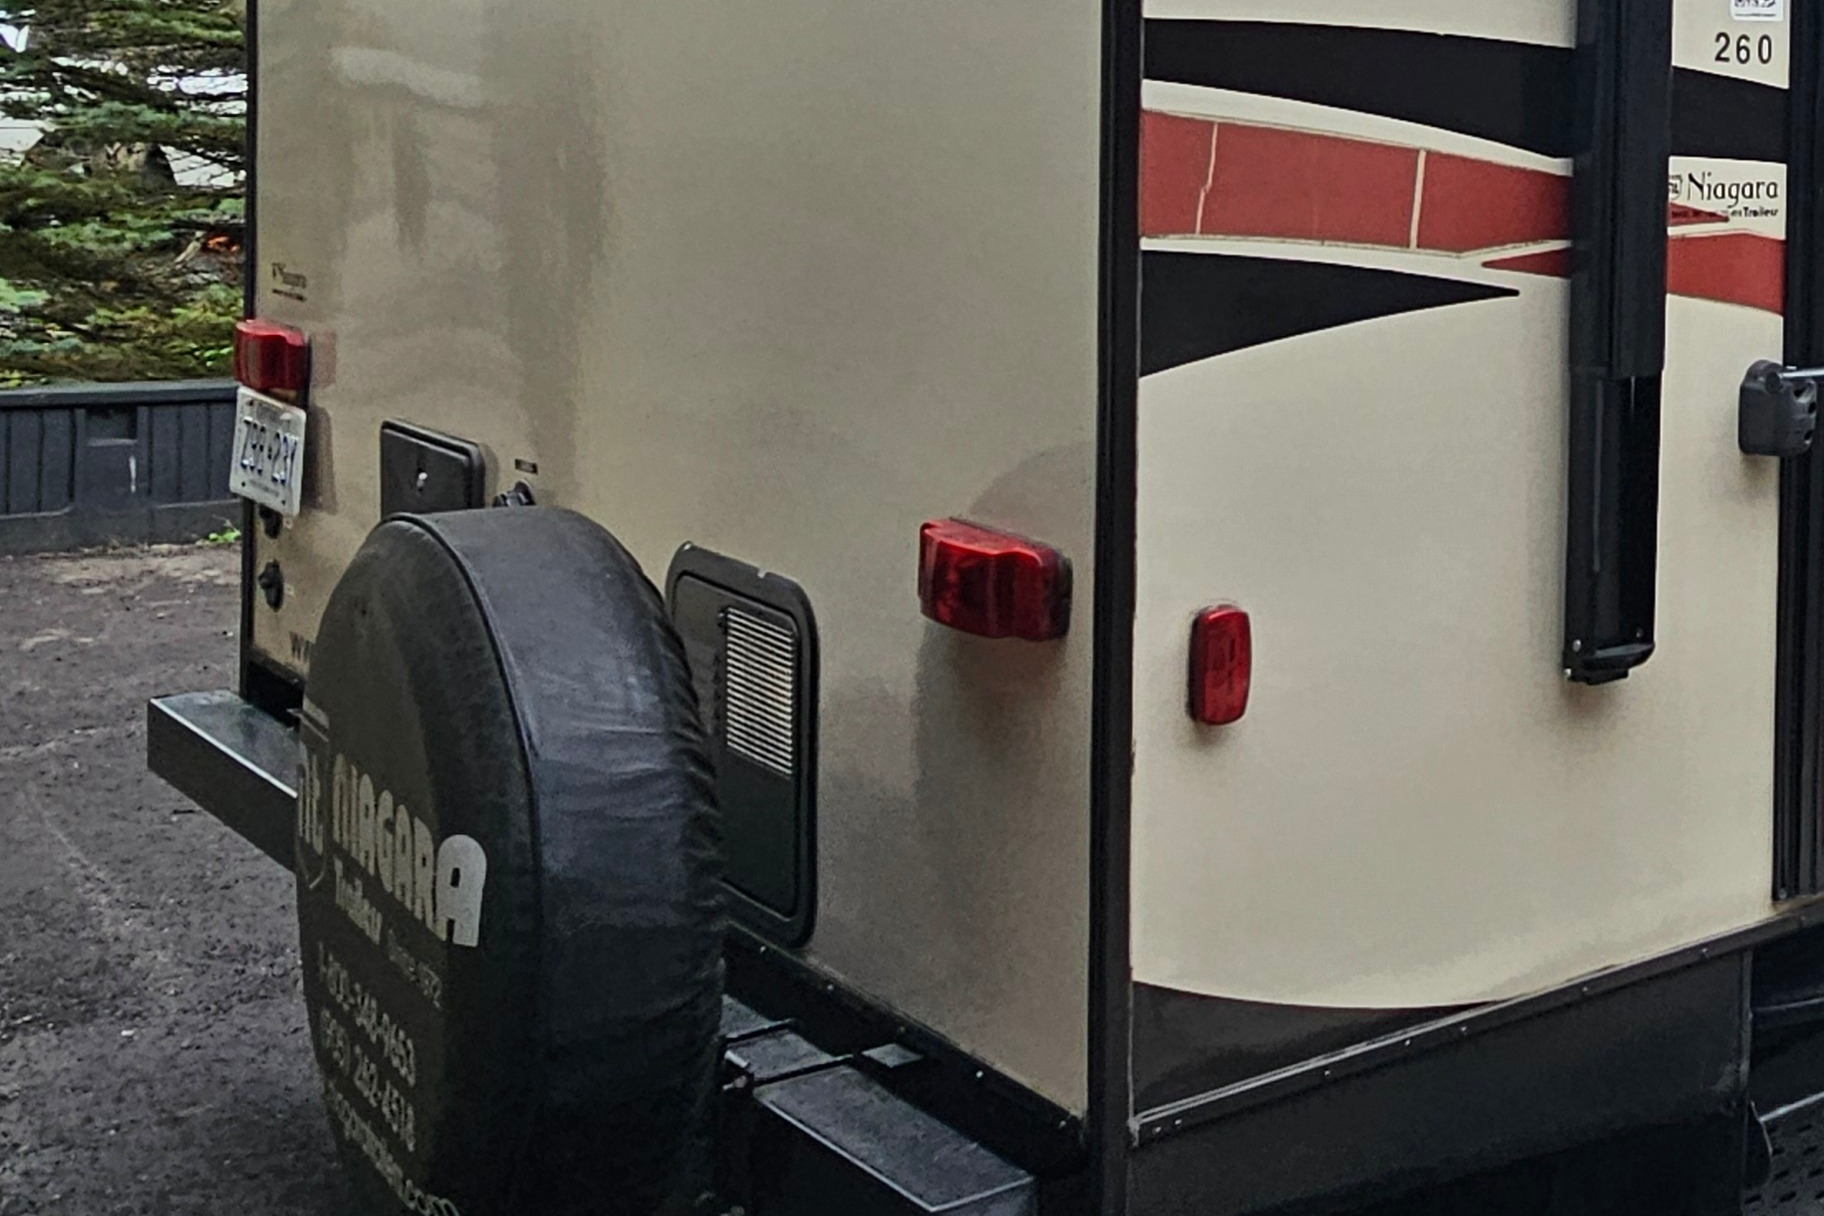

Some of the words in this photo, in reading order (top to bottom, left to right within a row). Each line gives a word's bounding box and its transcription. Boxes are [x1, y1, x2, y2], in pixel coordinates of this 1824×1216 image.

[1714, 31, 1773, 65] 260
[1687, 170, 1779, 209] Niagara
[333, 753, 487, 947] NIAGARA
